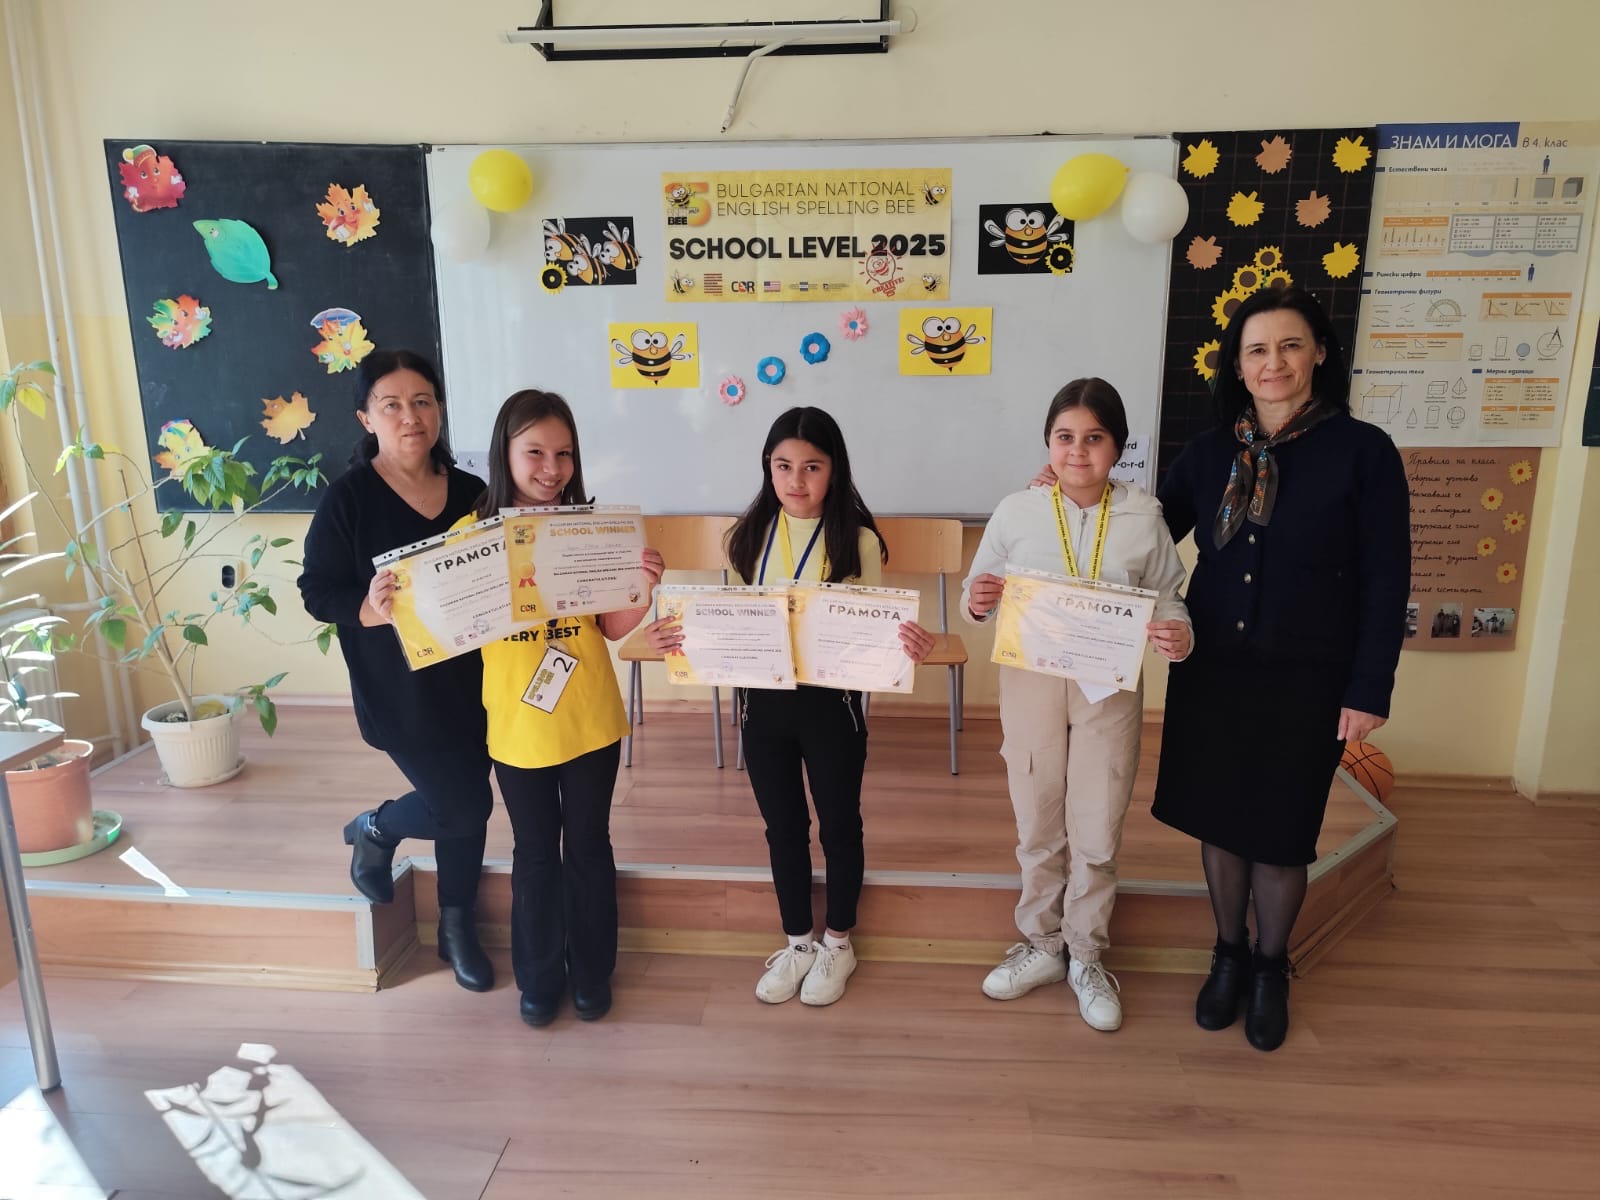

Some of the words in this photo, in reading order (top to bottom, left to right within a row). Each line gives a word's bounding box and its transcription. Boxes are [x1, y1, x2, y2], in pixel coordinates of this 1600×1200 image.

[1390, 134, 1440, 149] ЗНАМ
[1445, 133, 1459, 148] И
[1461, 133, 1513, 148] МОГА
[1544, 136, 1569, 148] клас
[716, 182, 818, 198] BULGARIAN
[825, 181, 915, 196] NATIONAL
[717, 200, 790, 216] ENGLISH
[796, 200, 879, 215] SPELLING
[885, 199, 916, 214] BEE
[667, 216, 688, 226] BEE
[669, 236, 782, 260] SCHOOL
[788, 235, 866, 259] LEVEL
[871, 234, 946, 257] 2025
[550, 527, 593, 537] SCHOOL
[695, 608, 735, 617] SCHOOL
[737, 608, 777, 617] WINNER
[828, 604, 901, 621] ГРАМОТА
[1055, 596, 1134, 618] ГРАМОТА
[543, 626, 582, 640] BEST
[552, 656, 574, 673] 2
